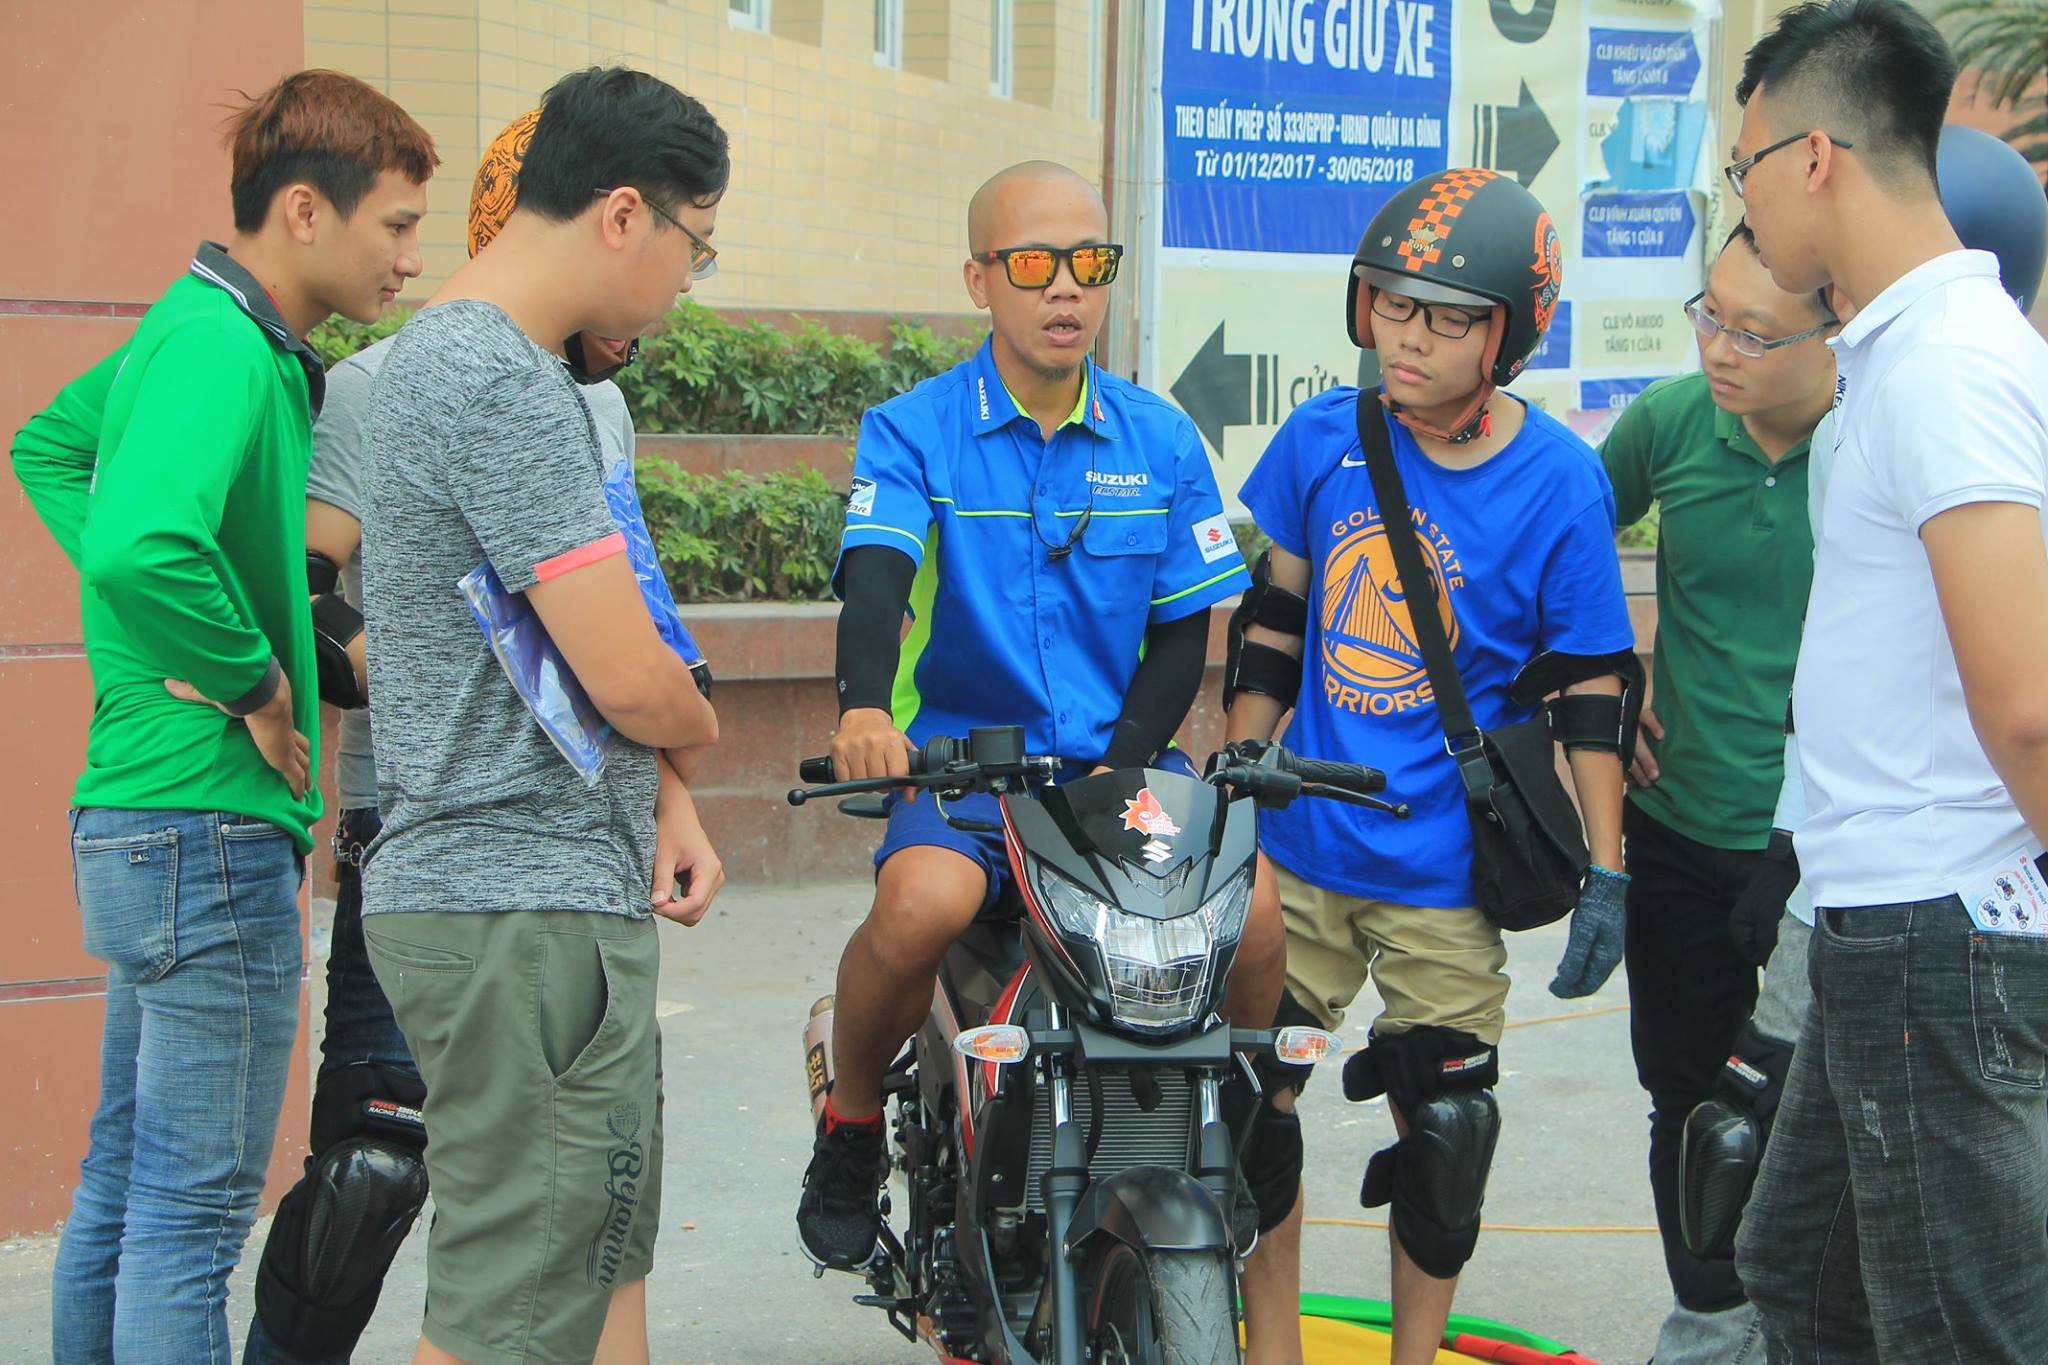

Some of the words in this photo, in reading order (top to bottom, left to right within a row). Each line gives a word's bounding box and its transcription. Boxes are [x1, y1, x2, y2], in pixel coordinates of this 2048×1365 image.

[1394, 2, 1434, 78] XE
[1175, 105, 1204, 138] THEO
[1207, 98, 1233, 140] GIẤY
[1235, 102, 1264, 141] PHÉP
[1266, 102, 1282, 142] SỐ
[1371, 110, 1399, 151] QUẬN
[1401, 117, 1414, 147] BA
[1195, 149, 1219, 177] Từ
[1221, 151, 1316, 181] 01/12/2017
[1326, 155, 1414, 184] 30/05/2018
[1408, 238, 1435, 253] Royal
[977, 377, 990, 420] SUZUKI
[1835, 374, 1847, 406] NIKE
[1085, 470, 1148, 486] SUZUKI
[1204, 538, 1233, 553] SUZUKI
[1428, 522, 1465, 592] STATE
[368, 1107, 395, 1116] RACING
